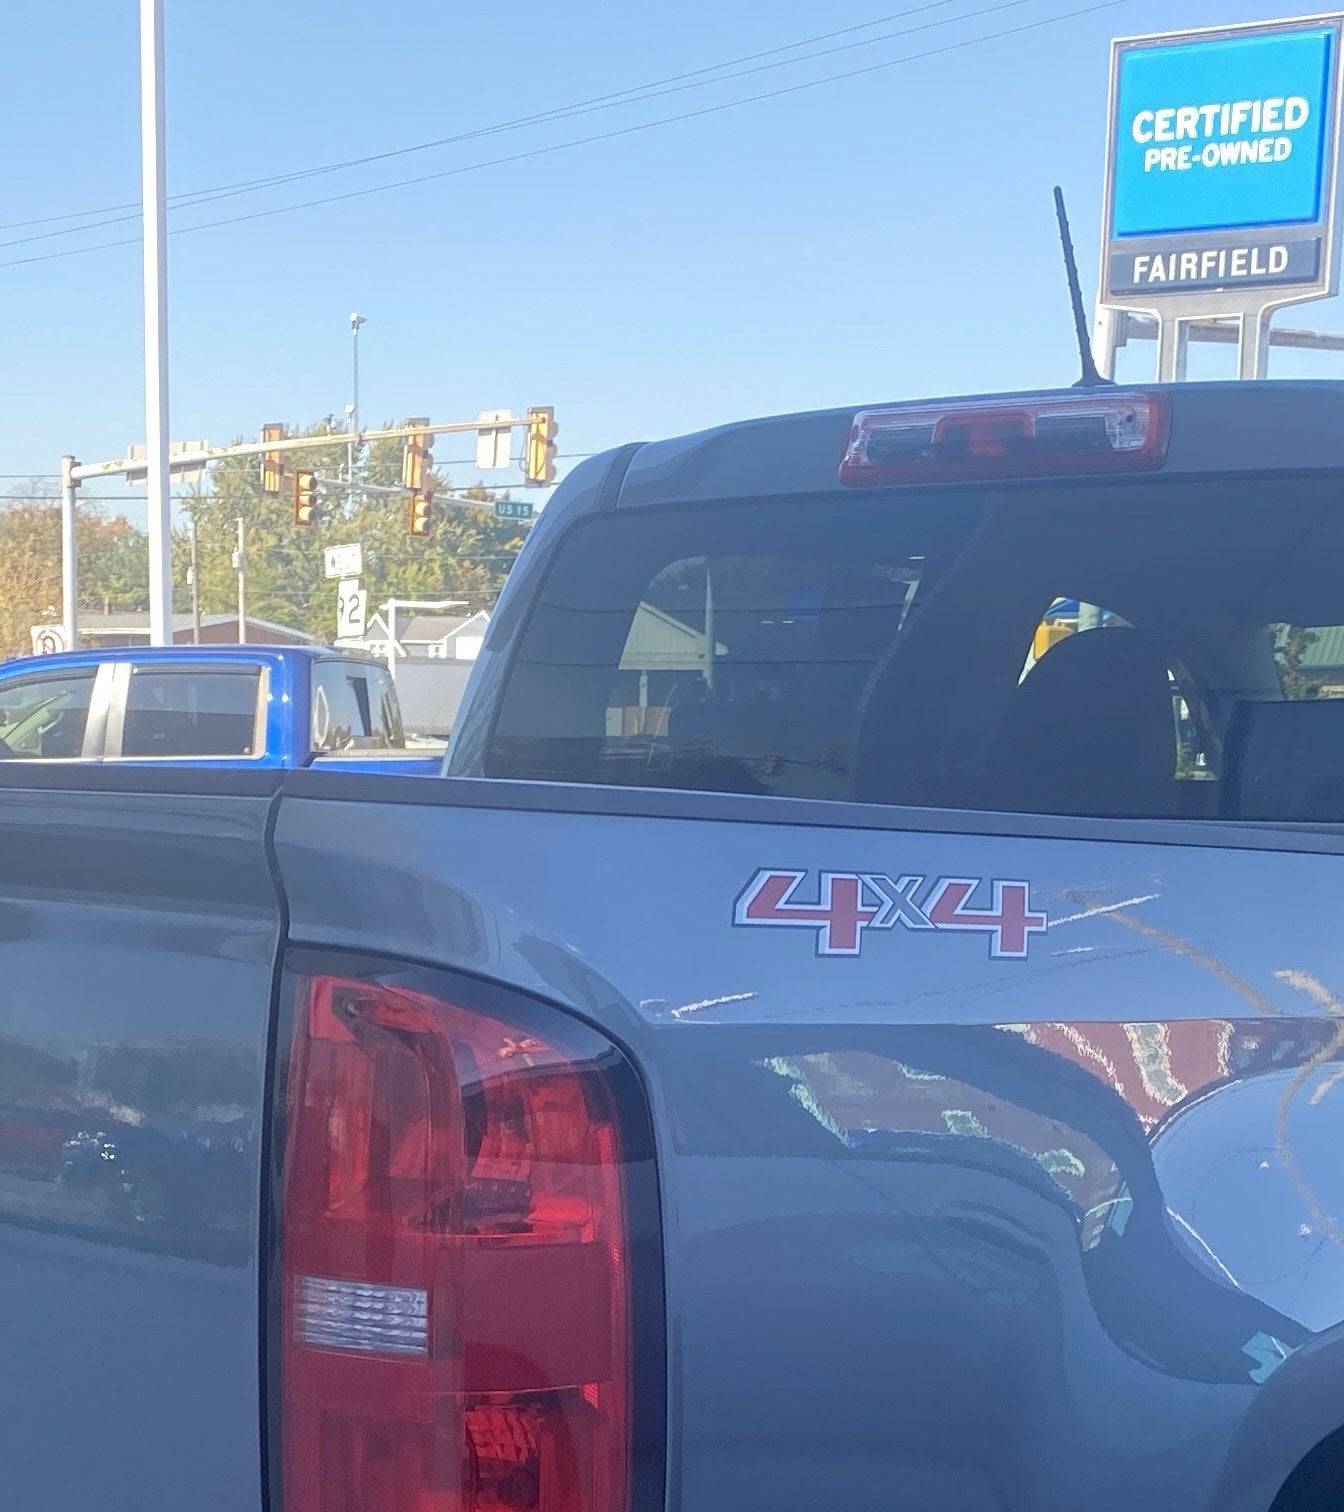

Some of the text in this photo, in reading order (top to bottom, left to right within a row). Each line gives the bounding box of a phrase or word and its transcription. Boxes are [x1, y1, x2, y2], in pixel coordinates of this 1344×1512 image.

[1132, 96, 1309, 143] CERTIFIED
[1144, 137, 1292, 173] PRE-OWNED
[1133, 246, 1288, 284] FAIRFIELD
[498, 503, 529, 516] US 15
[731, 867, 1048, 961] 4X4
